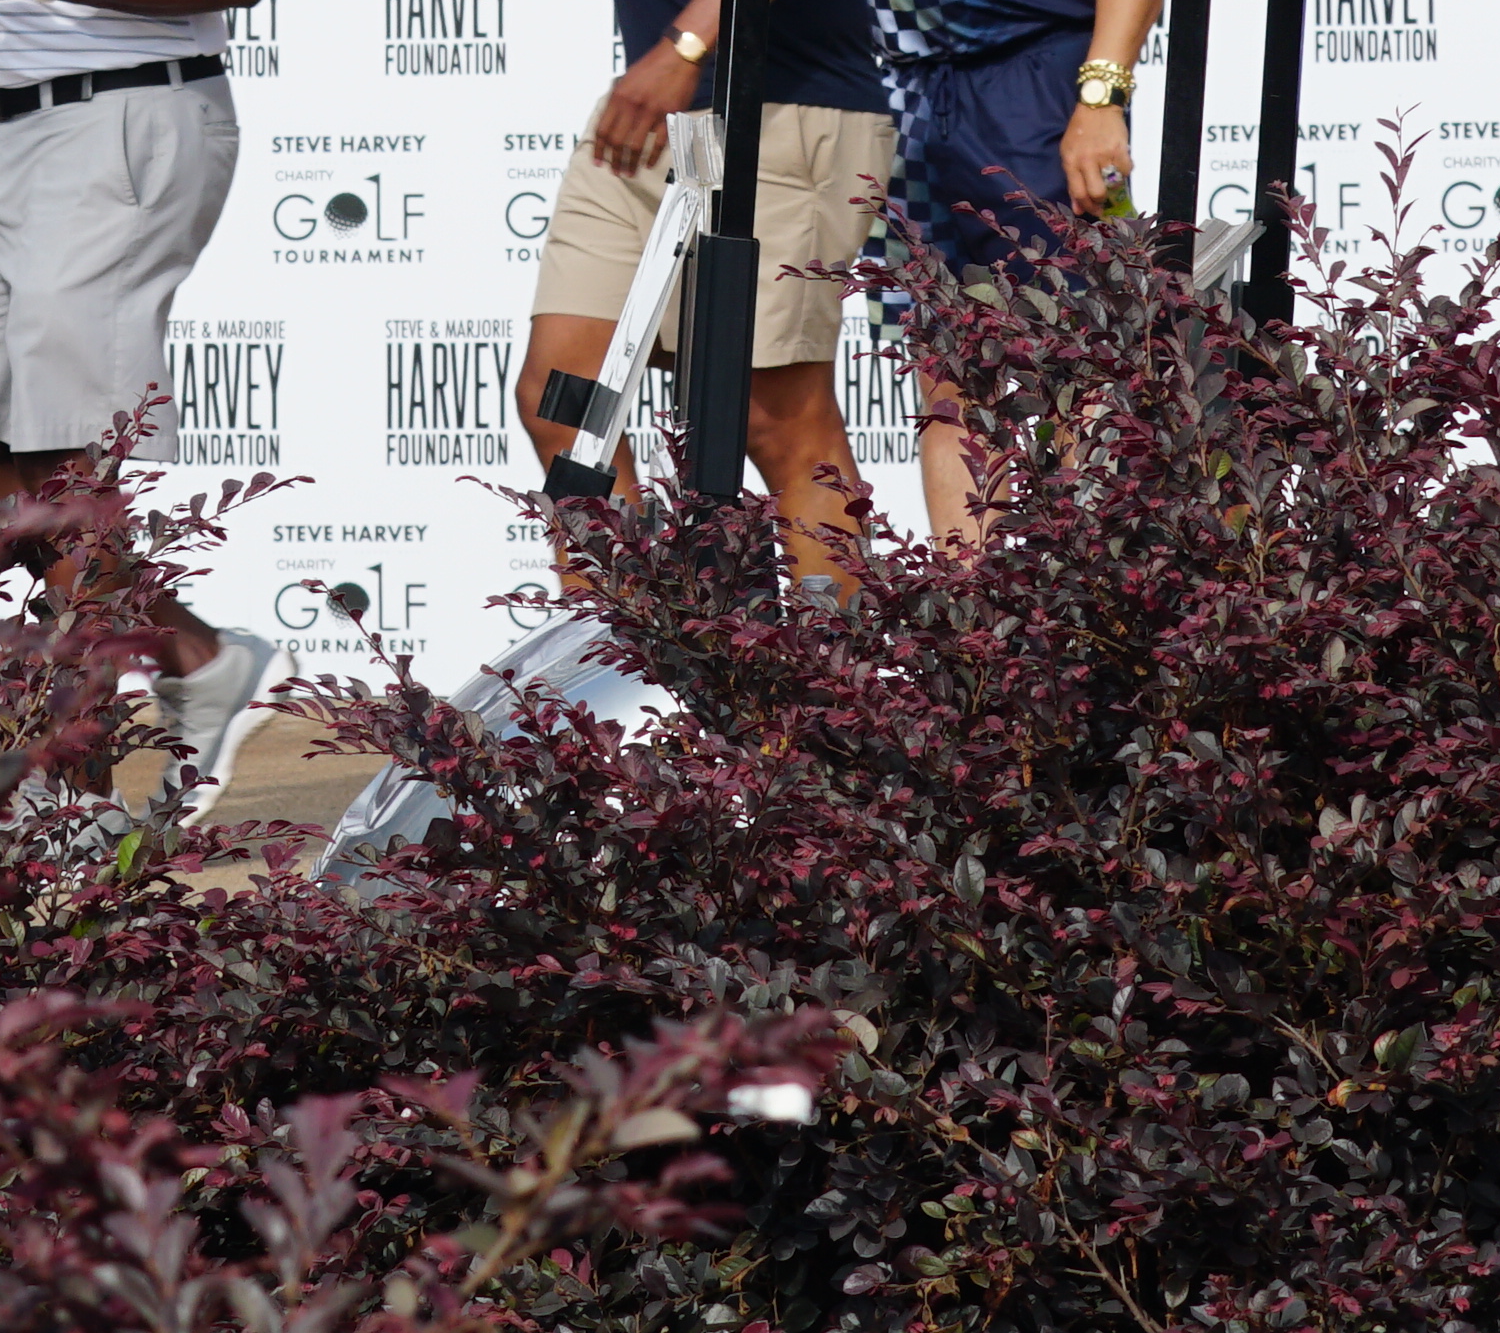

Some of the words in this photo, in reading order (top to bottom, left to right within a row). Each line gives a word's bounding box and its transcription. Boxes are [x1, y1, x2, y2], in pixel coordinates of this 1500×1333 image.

[1316, 29, 1436, 62] FOUNDATION
[386, 43, 506, 75] FOUNDATION
[1440, 122, 1499, 139] STEVE
[273, 136, 331, 153] STEVE
[341, 136, 425, 152] HARVEY
[275, 170, 334, 182] CHARITY
[274, 250, 423, 263] TOURNAMENT
[386, 320, 422, 338] STEVE
[430, 322, 438, 338] &
[446, 320, 511, 338] MARJORIE
[387, 343, 511, 429] HARVEY
[387, 433, 507, 466] FOUNDATION
[274, 525, 332, 542] STEVE
[343, 525, 427, 541] HARVEY
[276, 558, 335, 571] CHARITY
